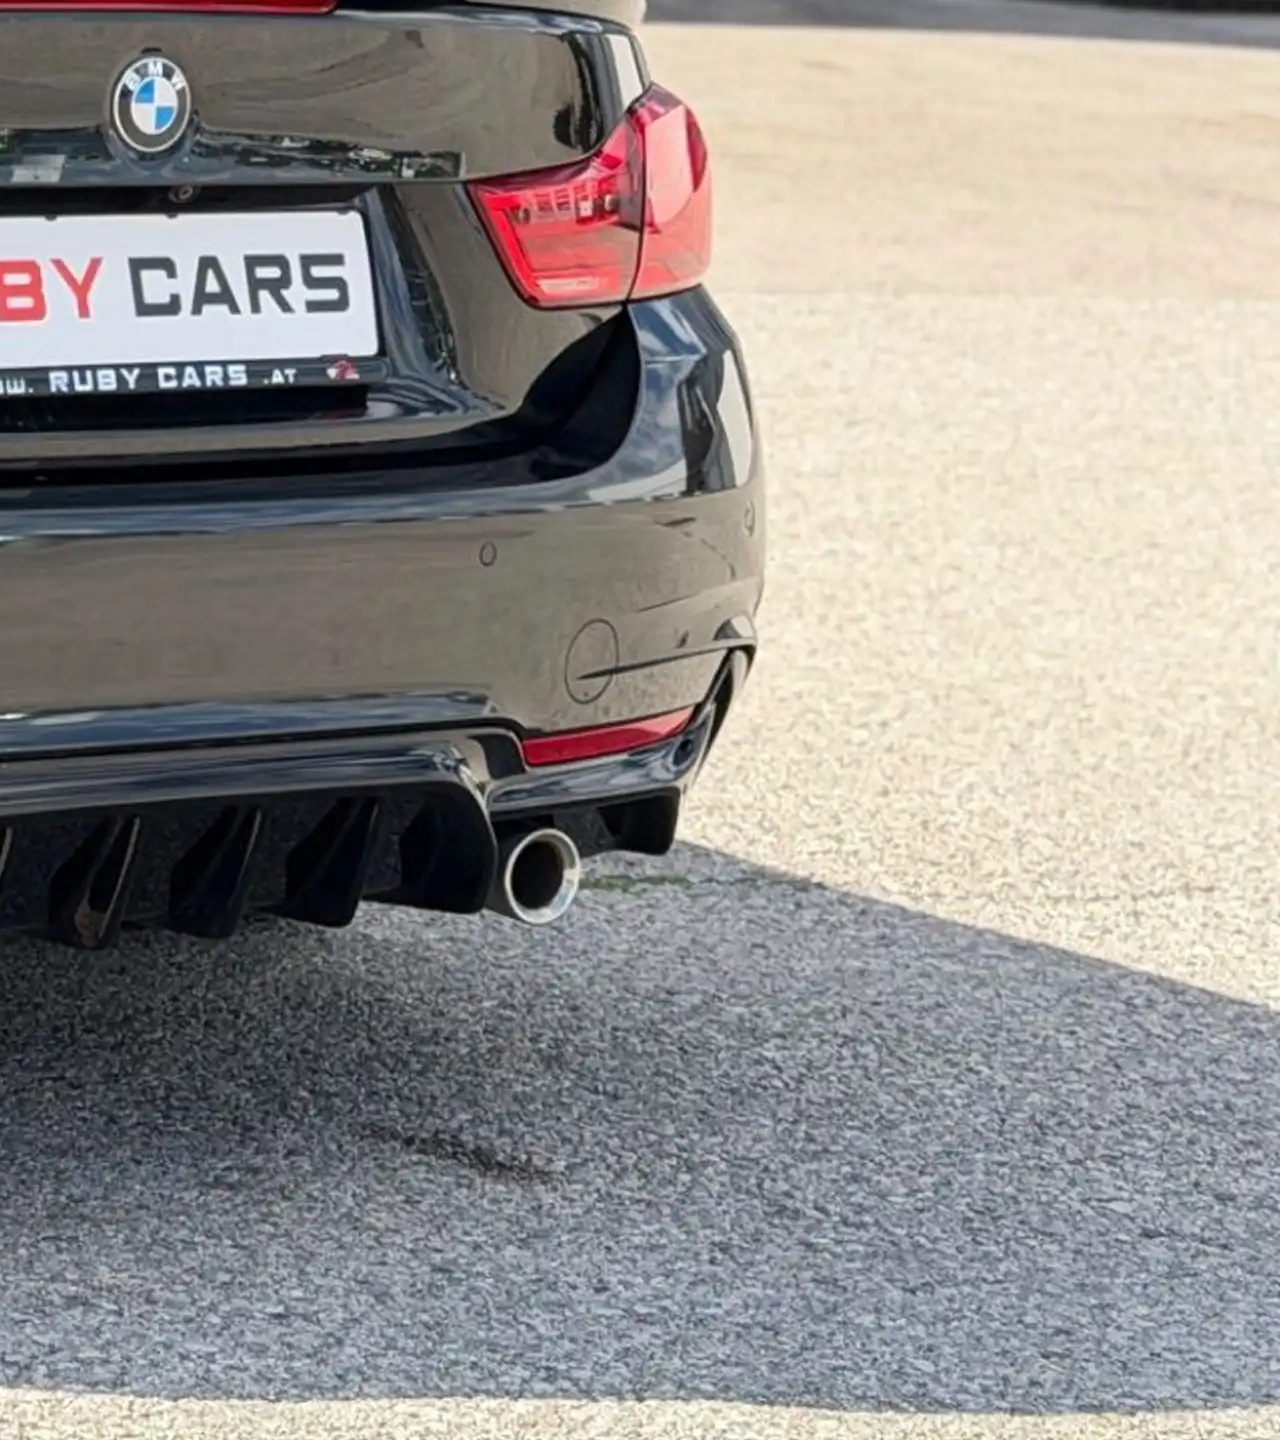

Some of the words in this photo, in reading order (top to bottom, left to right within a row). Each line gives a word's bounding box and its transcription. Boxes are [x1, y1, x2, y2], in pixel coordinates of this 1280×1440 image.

[123, 59, 187, 92] BMW
[127, 253, 350, 318] CARS
[48, 367, 140, 392] RUBY
[157, 364, 248, 389] CARS
